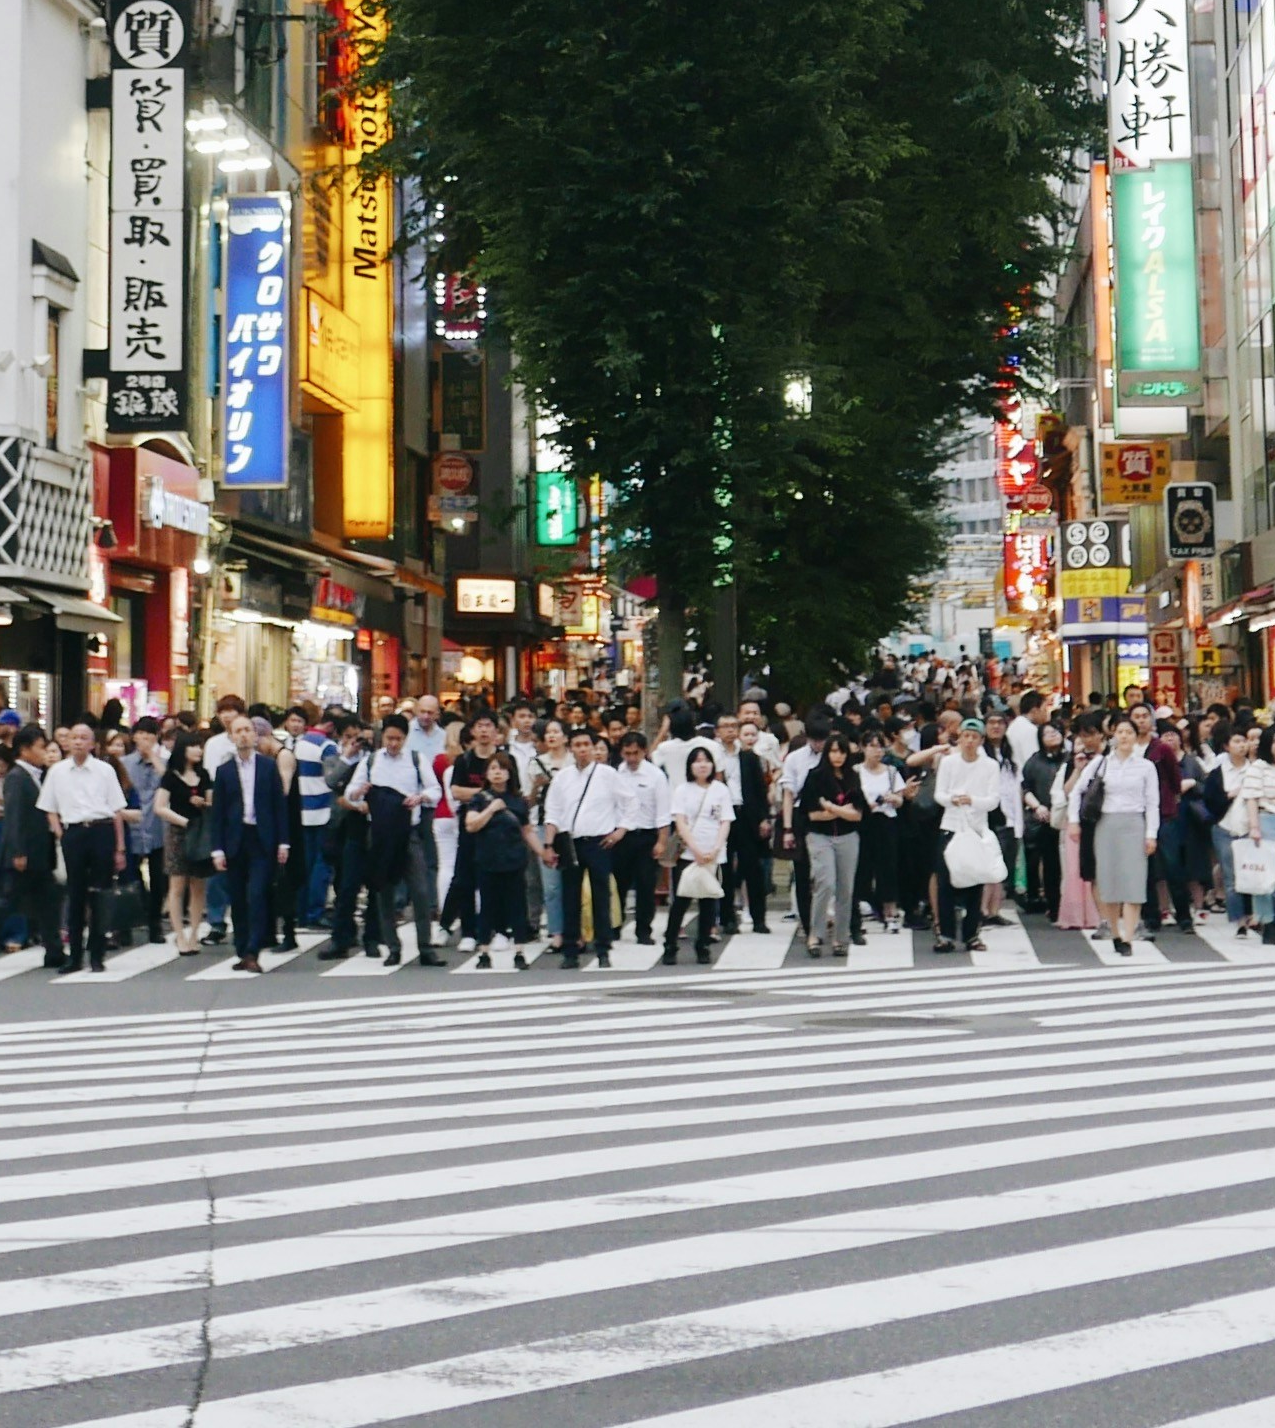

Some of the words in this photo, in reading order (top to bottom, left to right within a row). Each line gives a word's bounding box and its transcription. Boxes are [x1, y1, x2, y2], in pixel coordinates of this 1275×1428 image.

[125, 9, 175, 60] 質
[257, 241, 283, 376] クロサワ
[126, 375, 166, 389] 2号店
[227, 314, 257, 473] バイオリン
[112, 388, 179, 417] 銀蔵
[1121, 450, 1150, 476] 質
[1121, 484, 1151, 493] 大黒屋
[1171, 547, 1189, 556] TAX
[1191, 547, 1215, 557] FREE
